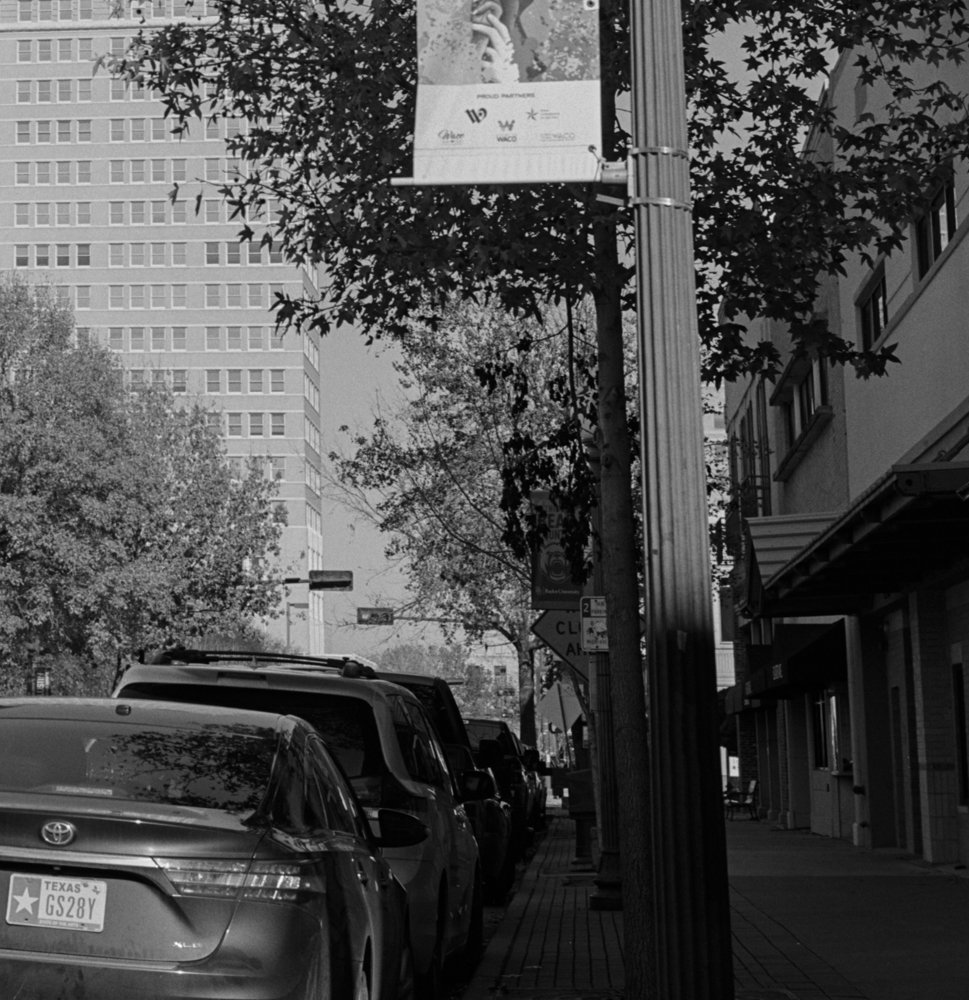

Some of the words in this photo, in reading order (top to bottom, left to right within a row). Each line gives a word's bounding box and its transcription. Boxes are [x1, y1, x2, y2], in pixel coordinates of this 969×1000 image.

[496, 135, 518, 143] WACO
[582, 603, 589, 613] 2
[44, 880, 81, 893] TEXAS
[45, 894, 96, 920] GS28Y
